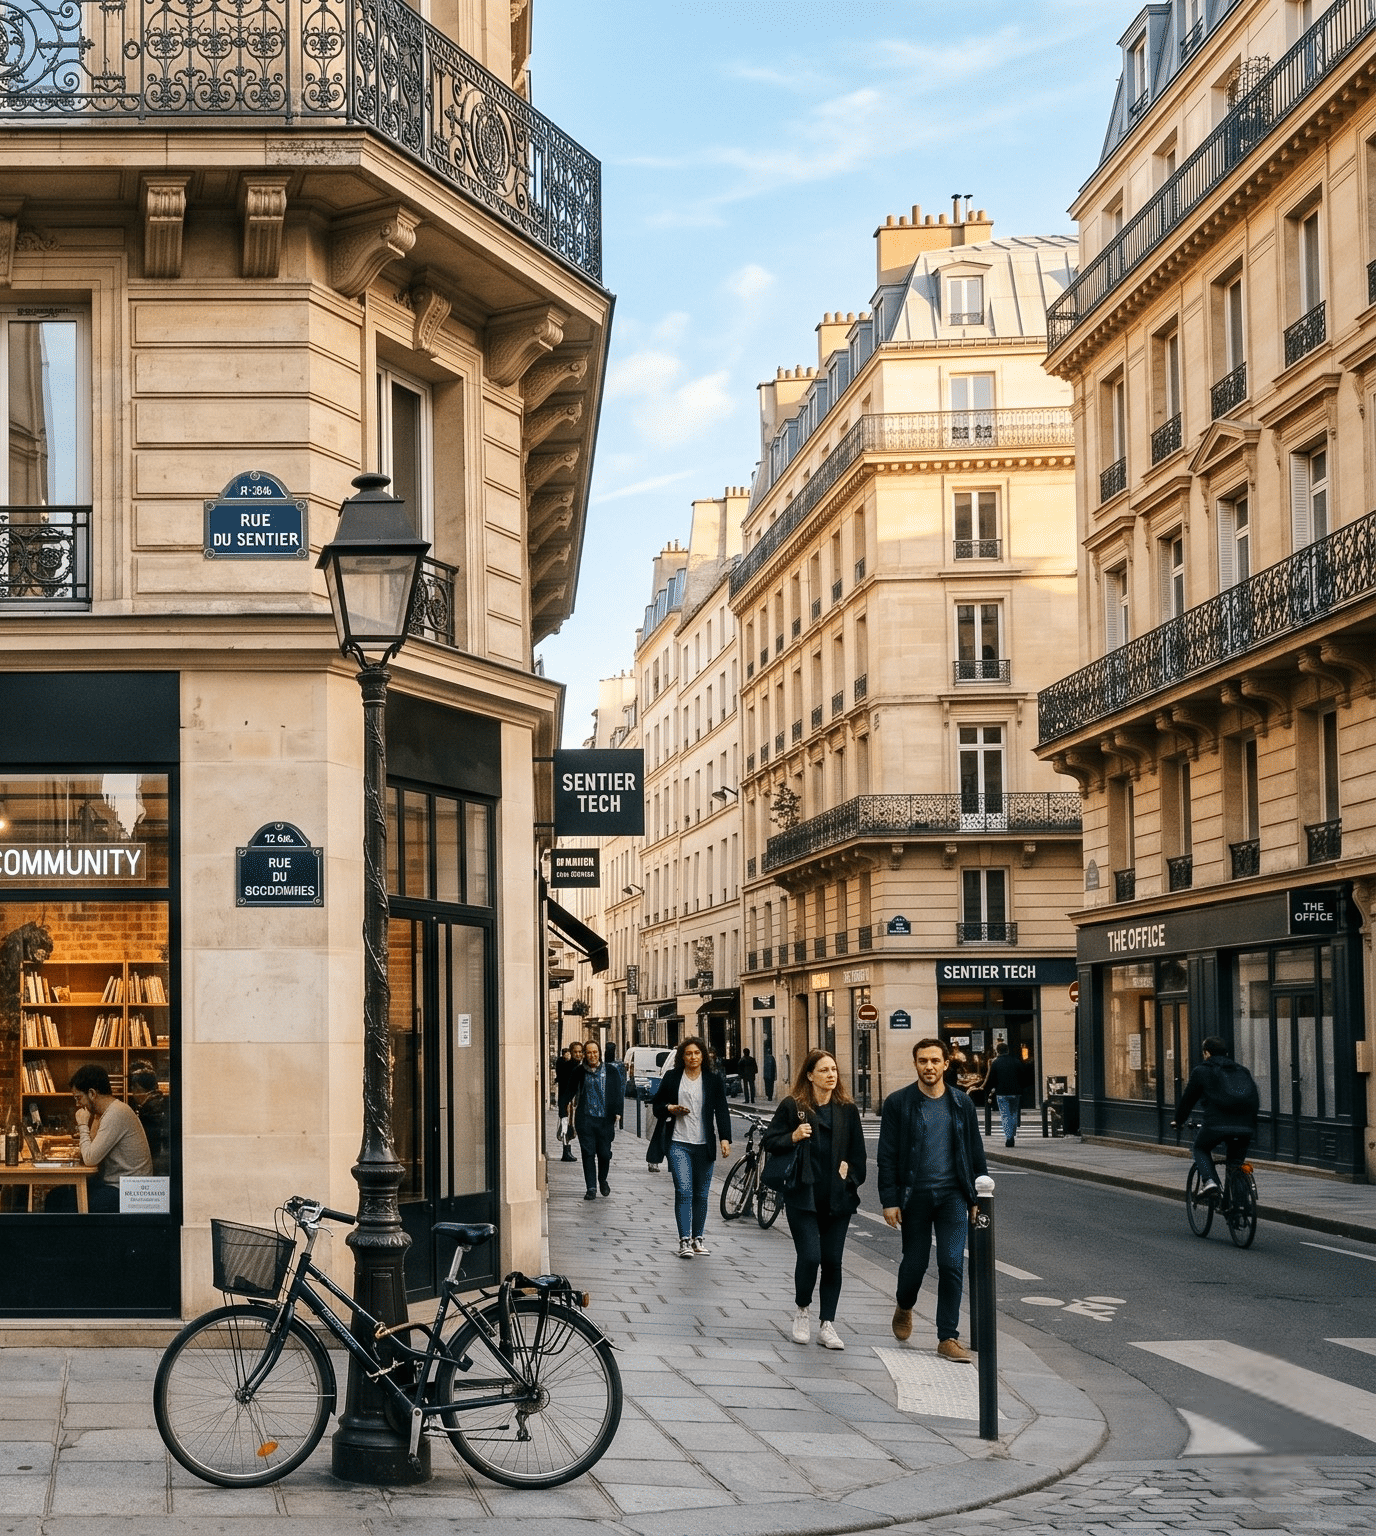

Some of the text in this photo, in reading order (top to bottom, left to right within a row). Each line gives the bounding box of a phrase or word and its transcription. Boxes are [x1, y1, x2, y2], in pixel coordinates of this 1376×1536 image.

[240, 513, 271, 527] RUE
[213, 532, 300, 546] DU SENTIER
[562, 773, 636, 792] SENTIER
[577, 794, 621, 813] TECH
[268, 857, 291, 868] RUE
[272, 871, 287, 882] DU
[1303, 902, 1324, 911] THE
[1294, 912, 1334, 921] OFFICE
[1107, 924, 1165, 952] THE OFFICE
[944, 965, 1036, 979] SENTIER TECH
